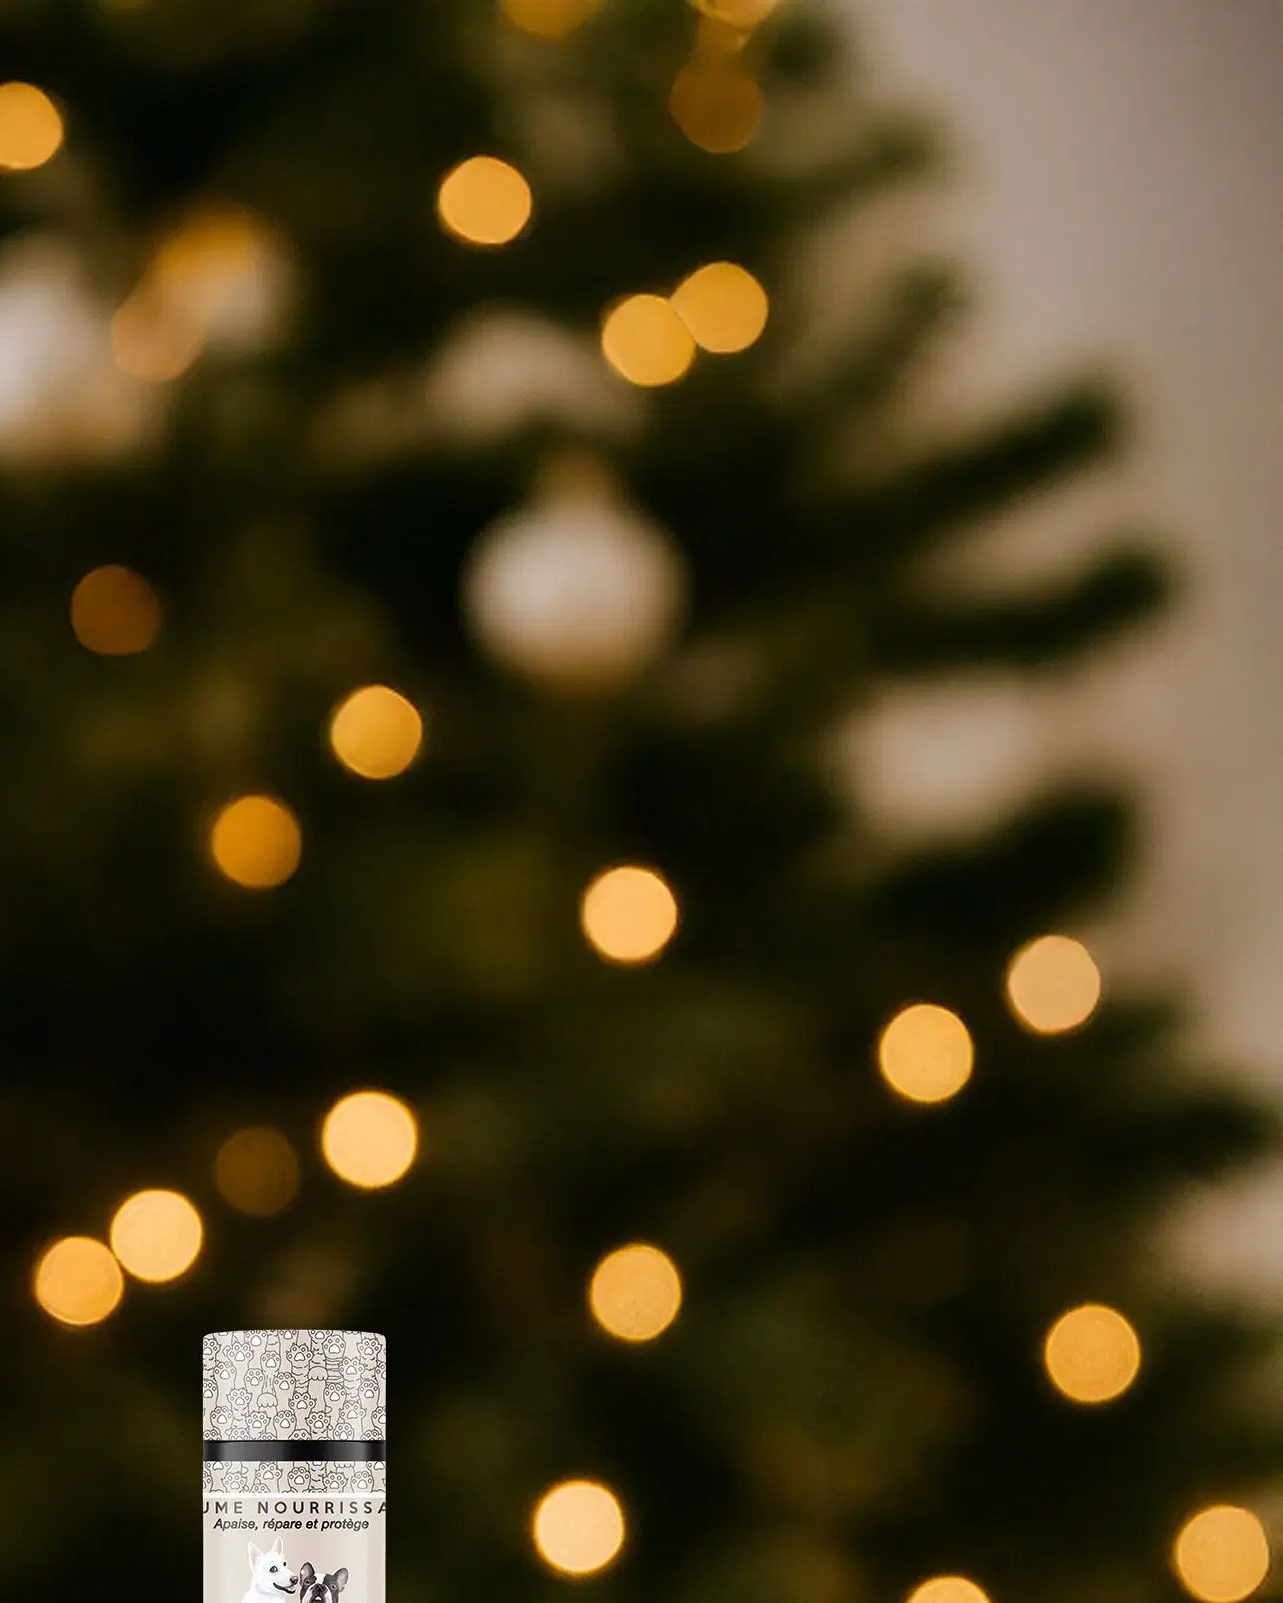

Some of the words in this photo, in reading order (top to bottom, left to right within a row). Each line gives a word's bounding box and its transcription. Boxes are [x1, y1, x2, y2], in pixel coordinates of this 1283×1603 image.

[213, 1518, 258, 1531] Apaise,
[262, 1518, 302, 1531] répare
[306, 1519, 318, 1529] et
[321, 1518, 369, 1531] protège
